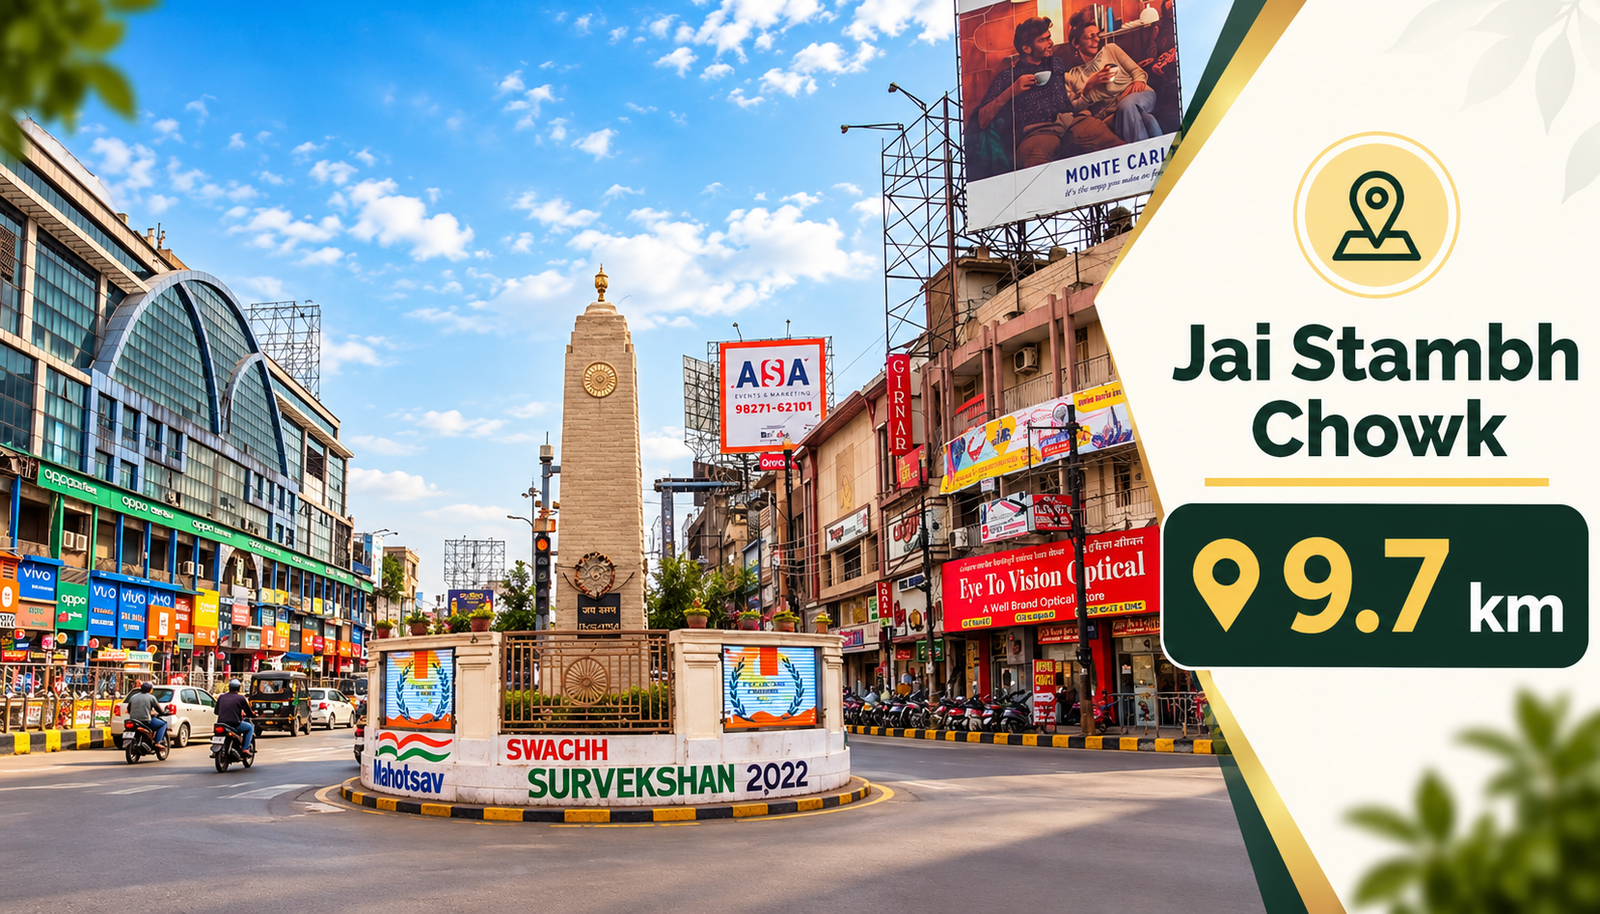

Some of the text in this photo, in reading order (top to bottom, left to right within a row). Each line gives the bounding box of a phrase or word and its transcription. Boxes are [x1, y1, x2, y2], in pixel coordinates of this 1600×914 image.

[1066, 158, 1120, 184] MONTE
[735, 401, 812, 414] 98271-62101
[893, 360, 907, 450] GIRNAR
[122, 496, 148, 512] oppo
[23, 563, 51, 581] vivo
[959, 578, 983, 604] Eye
[985, 572, 1005, 596] To
[1008, 566, 1062, 593] Vision
[61, 594, 86, 607] oppo
[983, 605, 989, 613] A
[990, 601, 1009, 613] Well
[1040, 593, 1075, 609] Optical
[507, 738, 608, 761] SWACHH
[373, 759, 445, 794] Mahotsav
[528, 760, 809, 799] SURVEKSHAN 2022
